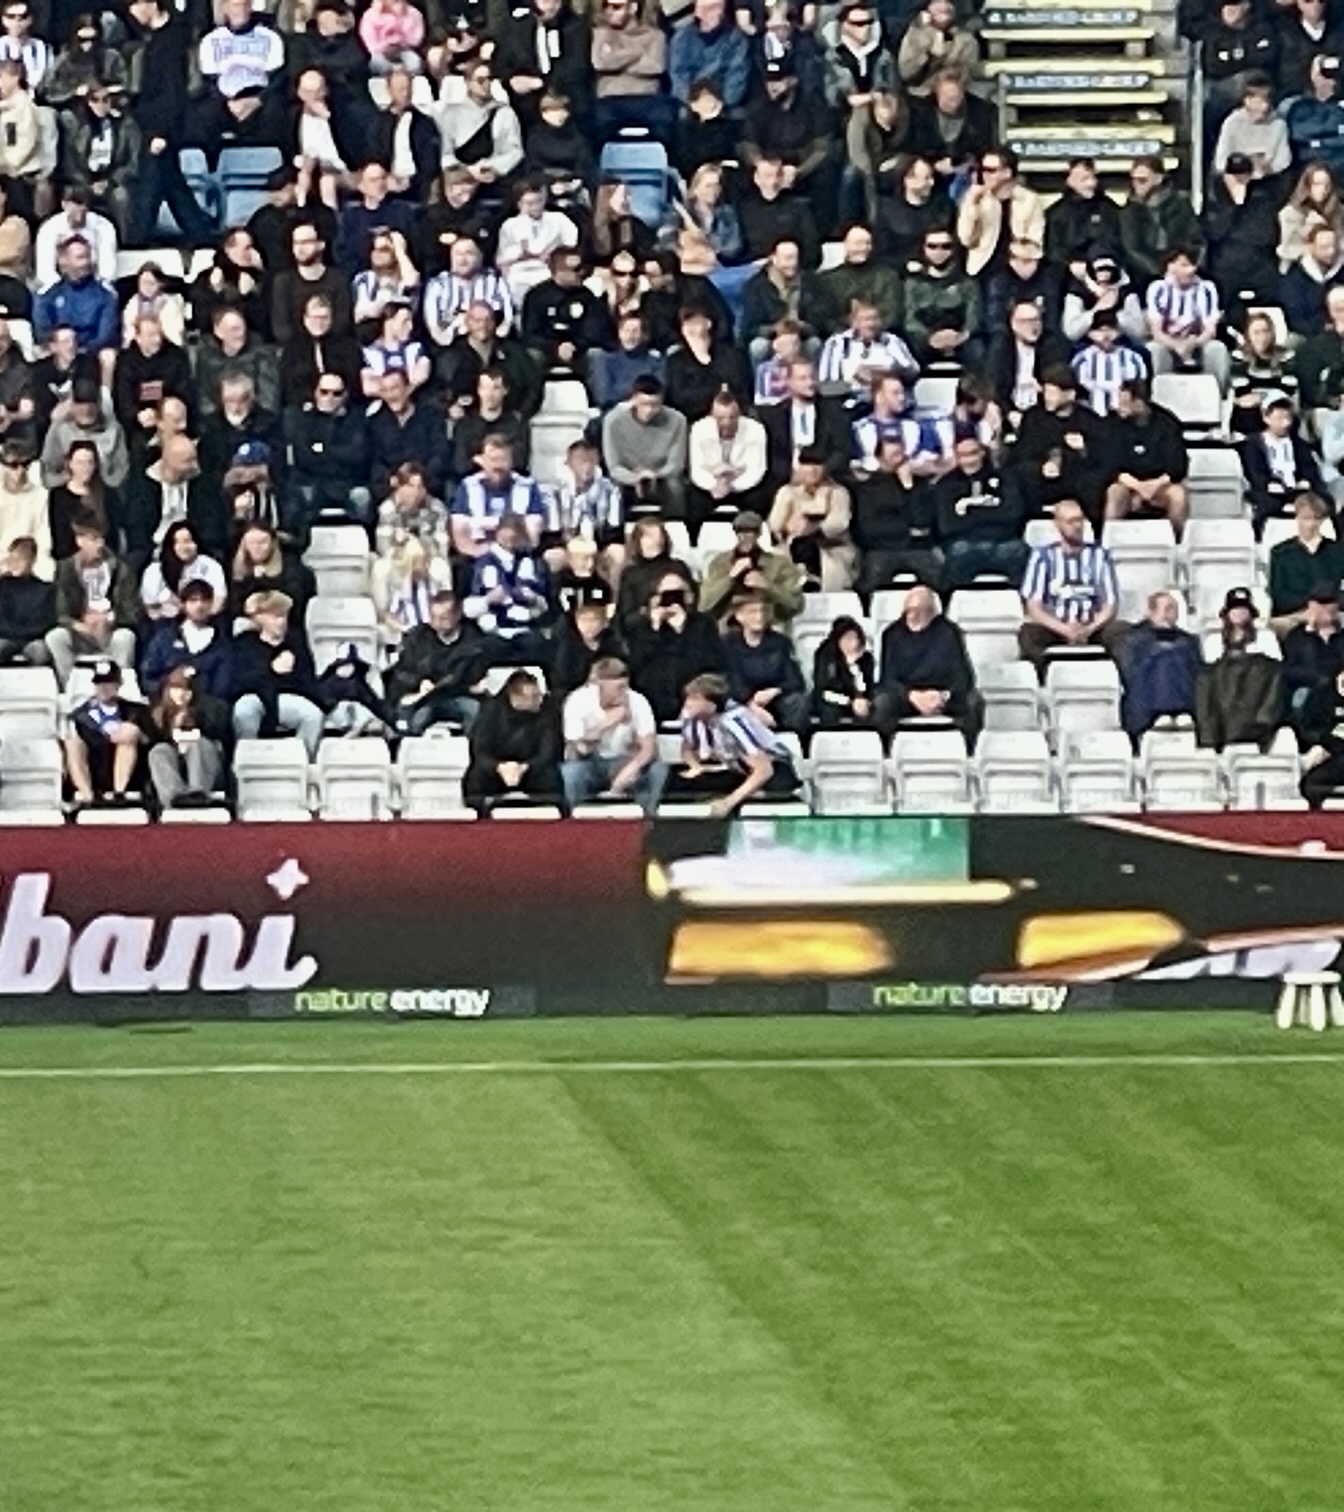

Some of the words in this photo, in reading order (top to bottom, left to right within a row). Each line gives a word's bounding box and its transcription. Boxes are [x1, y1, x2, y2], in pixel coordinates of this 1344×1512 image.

[295, 988, 387, 1011] nature
[390, 989, 489, 1016] energy
[873, 982, 966, 1006] nature
[969, 984, 1068, 1011] energy
